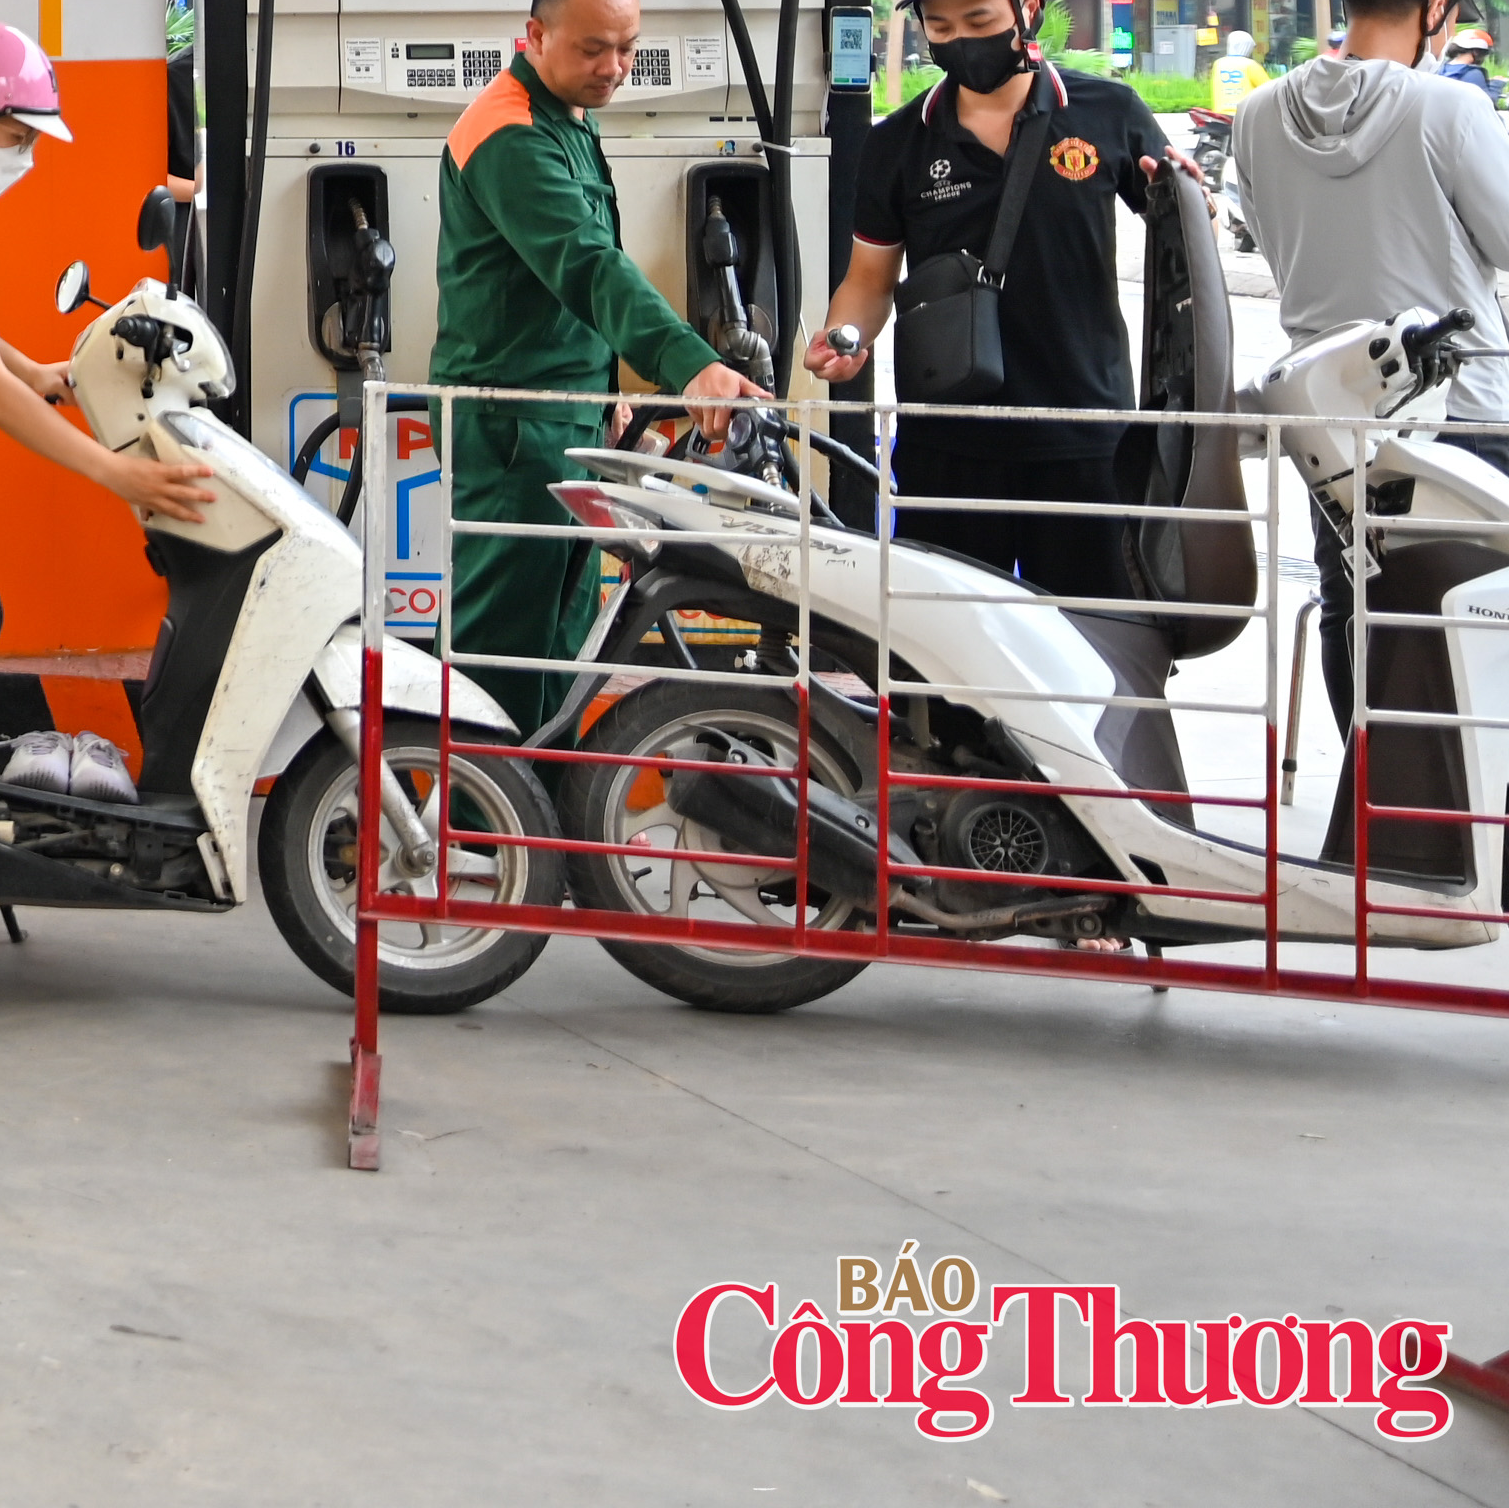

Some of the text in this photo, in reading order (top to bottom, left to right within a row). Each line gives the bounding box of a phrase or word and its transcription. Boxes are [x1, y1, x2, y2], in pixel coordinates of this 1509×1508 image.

[335, 140, 355, 156] 16
[921, 181, 972, 199] CHAMPIONS
[934, 191, 961, 200] LEAGUE
